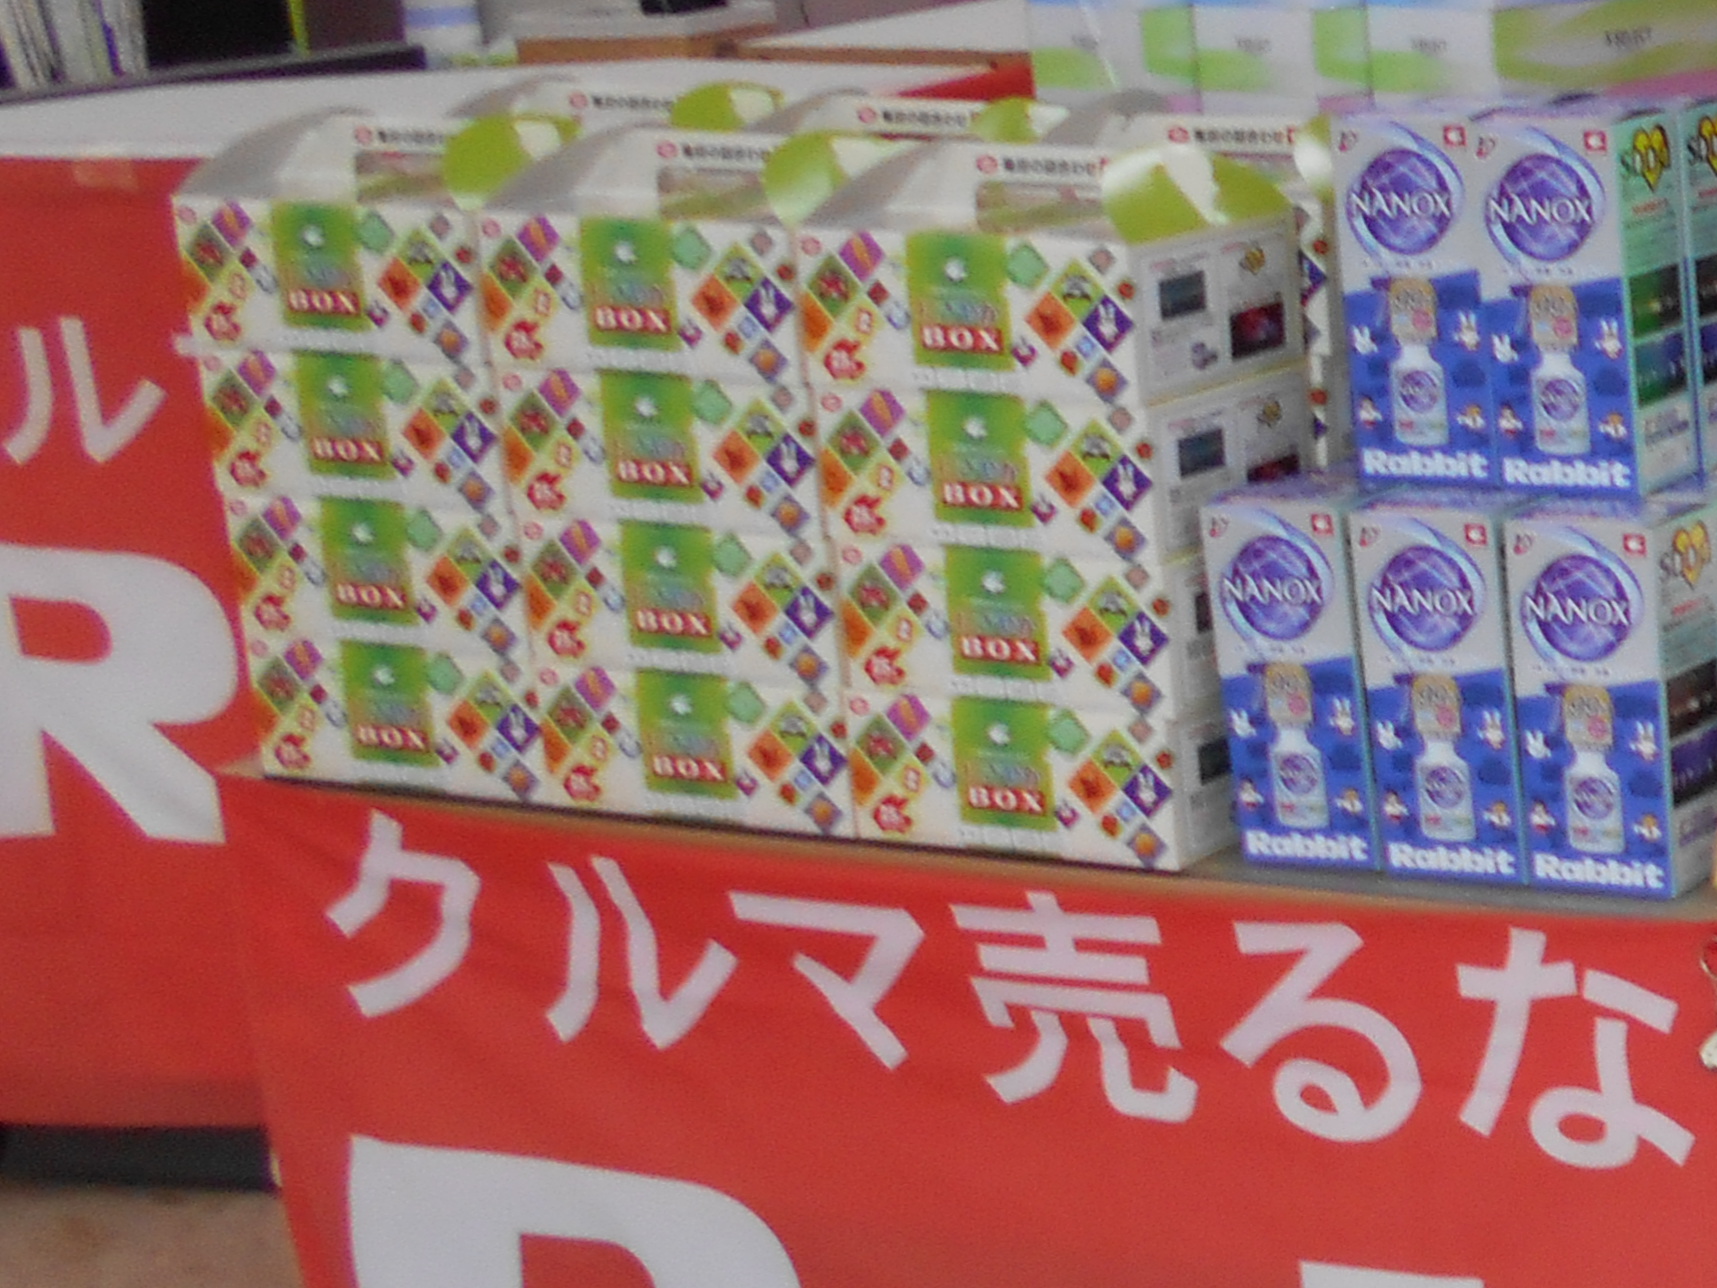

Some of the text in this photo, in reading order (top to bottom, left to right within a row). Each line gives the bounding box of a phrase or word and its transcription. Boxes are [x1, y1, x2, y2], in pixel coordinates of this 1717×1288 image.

[1350, 187, 1452, 221] NANOX
[1486, 191, 1594, 228] NANOX
[288, 288, 360, 315] BOX
[593, 305, 673, 333] BOX
[922, 324, 1000, 352] BOX
[311, 437, 384, 463] BOX
[1362, 448, 1490, 479] Rabbit
[615, 457, 690, 486] BOX
[1502, 455, 1631, 490] Rabbit
[943, 483, 1022, 510] BOX
[336, 583, 407, 609] BOX
[1222, 573, 1324, 606] NANOX
[1370, 582, 1475, 617] NANOX
[635, 610, 710, 637] BOX
[1524, 591, 1632, 629] NANOX
[960, 636, 1039, 664] BOX
[355, 725, 427, 750] BOX
[653, 755, 725, 783] BOX
[968, 786, 1045, 814] BOX
[1245, 828, 1369, 861] Rabbit
[1388, 839, 1516, 877] Rabbit
[1533, 852, 1666, 891] Rabbit
